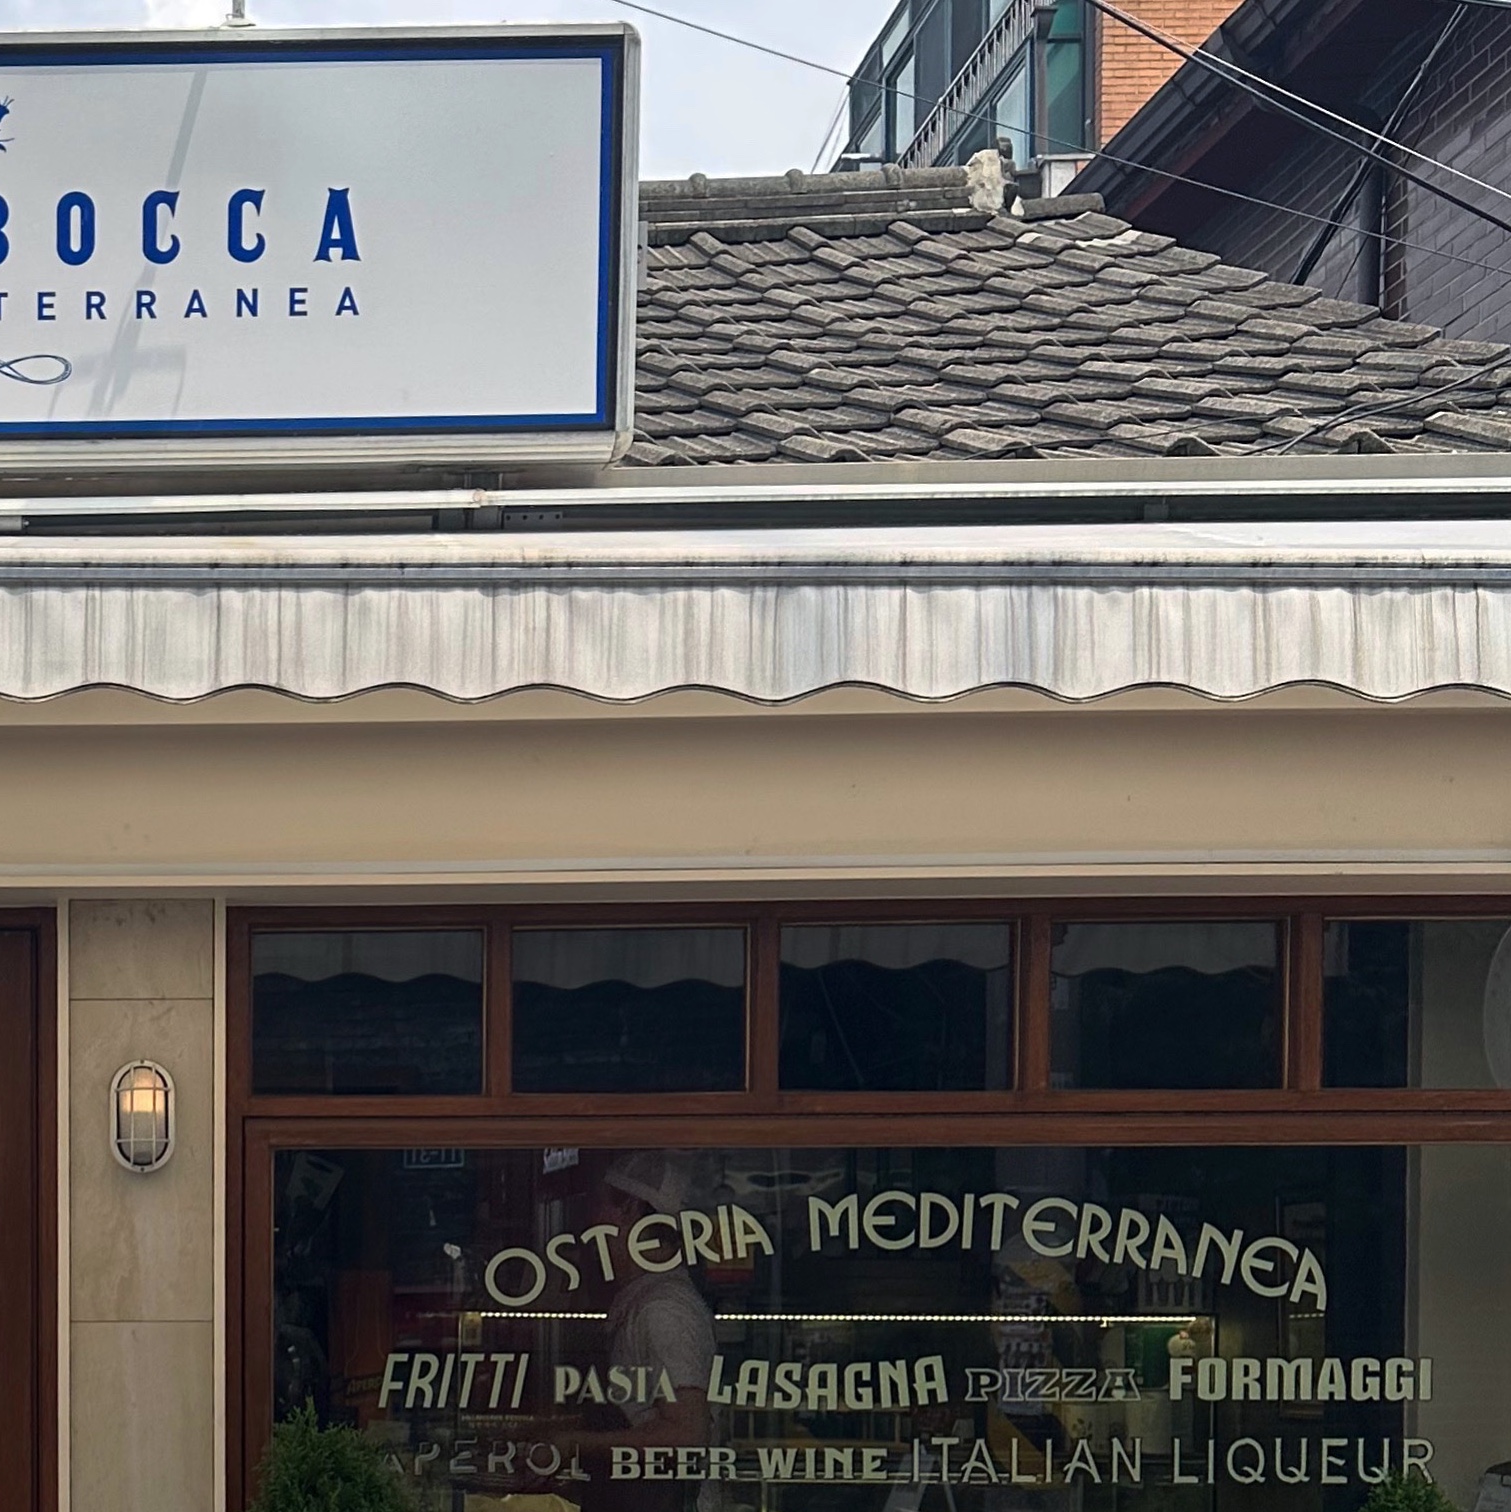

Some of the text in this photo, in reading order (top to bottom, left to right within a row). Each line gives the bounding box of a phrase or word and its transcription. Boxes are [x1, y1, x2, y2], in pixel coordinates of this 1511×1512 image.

[484, 1189, 1328, 1312] OSTERIA MEDITERRANEA
[378, 1352, 1433, 1411] FRITTI PASTA LASAGNA PIZZA FORMAGGI
[610, 1446, 738, 1480] BEER
[756, 1446, 889, 1480] WINE
[911, 1436, 1143, 1485] ITALIAN
[1172, 1437, 1434, 1485] LIQUEUR
